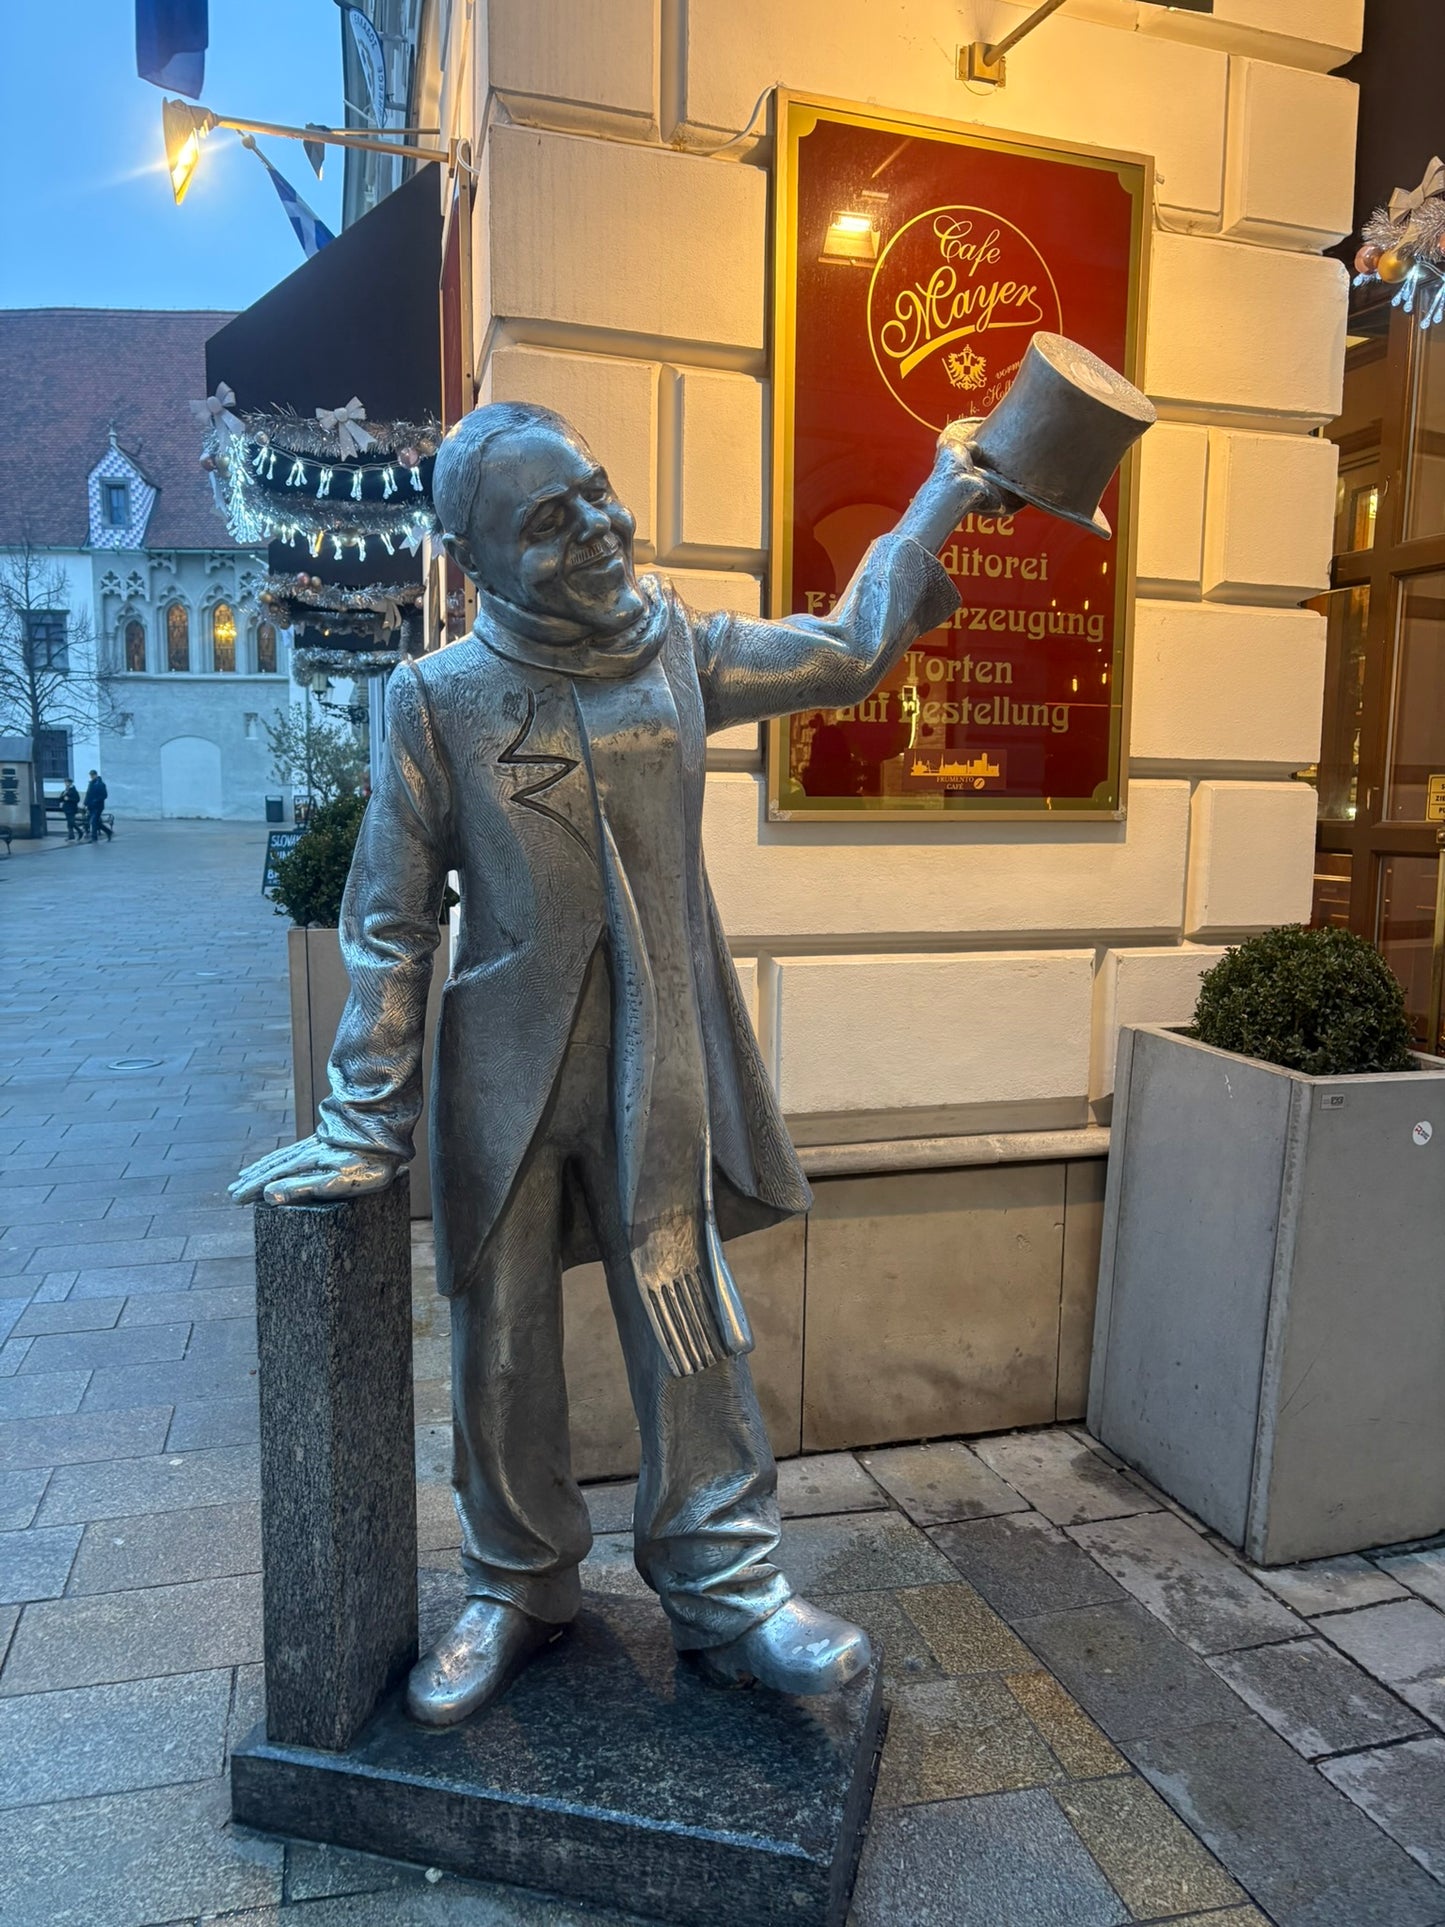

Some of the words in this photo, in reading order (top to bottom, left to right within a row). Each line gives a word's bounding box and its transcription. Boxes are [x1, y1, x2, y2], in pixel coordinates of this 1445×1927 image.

[933, 214, 1001, 277] Cafe
[881, 265, 1043, 358] Mayer
[940, 544, 1048, 581] ditorei
[936, 605, 1105, 642] rzeugung
[904, 650, 1013, 684] Torten
